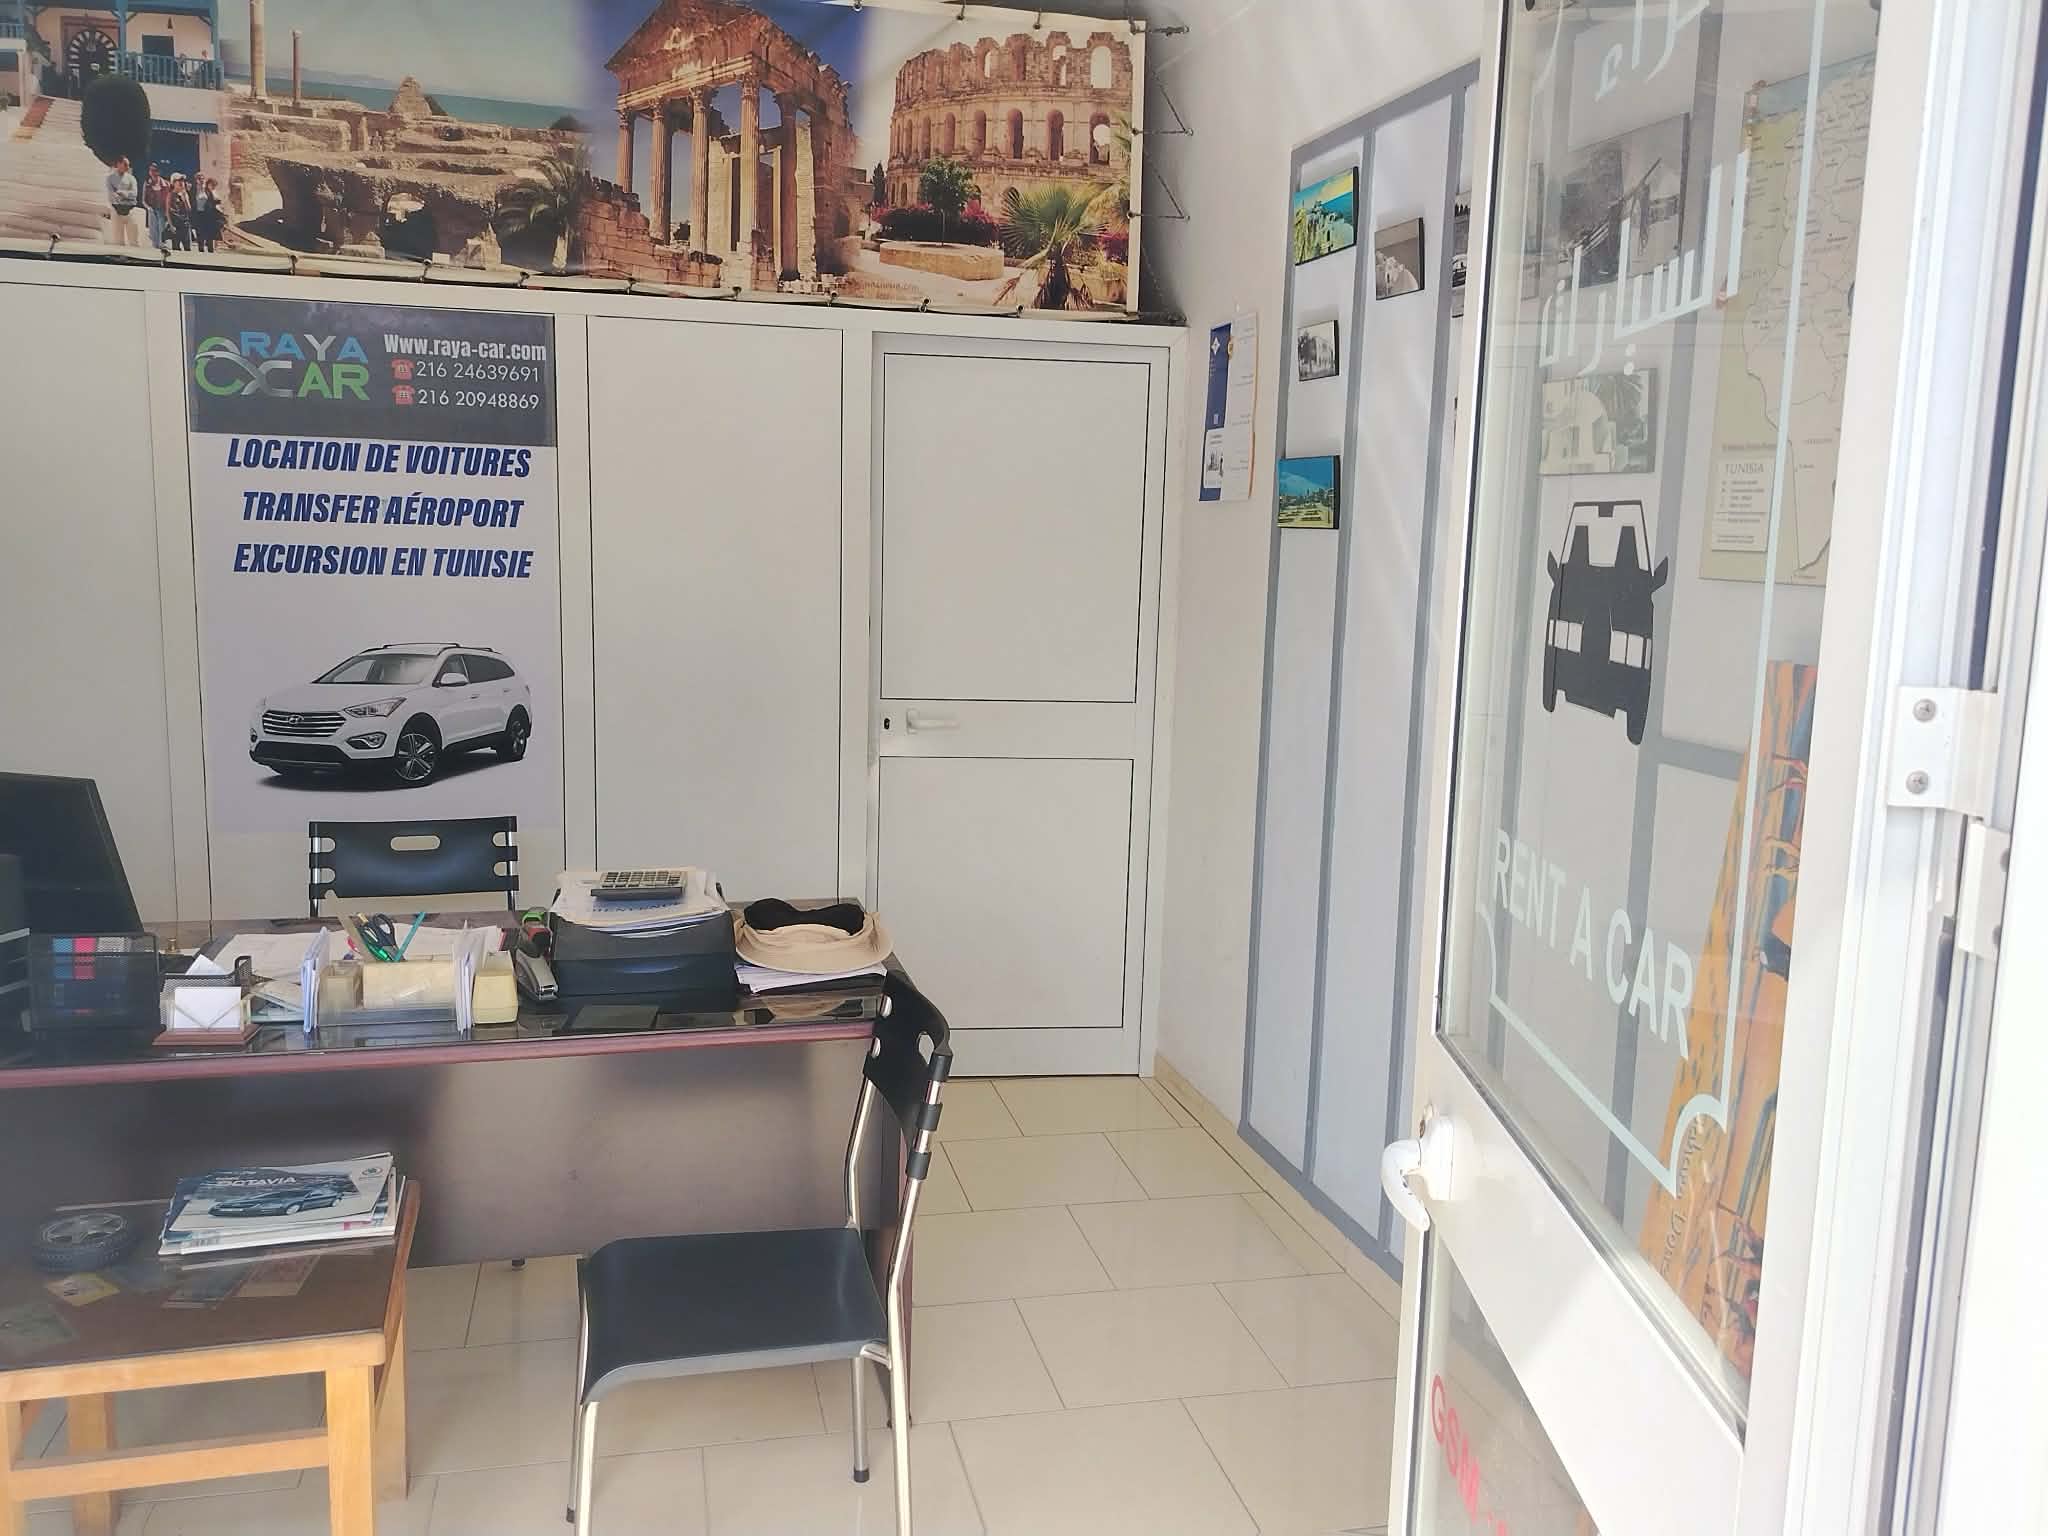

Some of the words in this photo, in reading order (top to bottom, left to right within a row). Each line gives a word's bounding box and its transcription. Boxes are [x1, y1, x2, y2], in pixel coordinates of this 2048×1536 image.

[240, 331, 369, 364] RAYA
[383, 333, 547, 362] Www.raya-car.com
[416, 360, 448, 379] 216
[453, 362, 540, 383] 24639691
[418, 389, 450, 406] 216
[455, 391, 540, 410] 20948869
[227, 438, 361, 472] LOCATION
[364, 443, 401, 474] DE
[405, 445, 532, 478] VOITURES
[243, 491, 380, 524] TRANSFER
[383, 490, 525, 528] AÉROPORT
[233, 543, 388, 576] EXCURSION
[391, 547, 426, 577] EN
[432, 548, 534, 579] TUNISIE
[1494, 827, 1567, 950] RENT
[1568, 886, 1593, 982] A
[1605, 907, 1694, 1063] CAR
